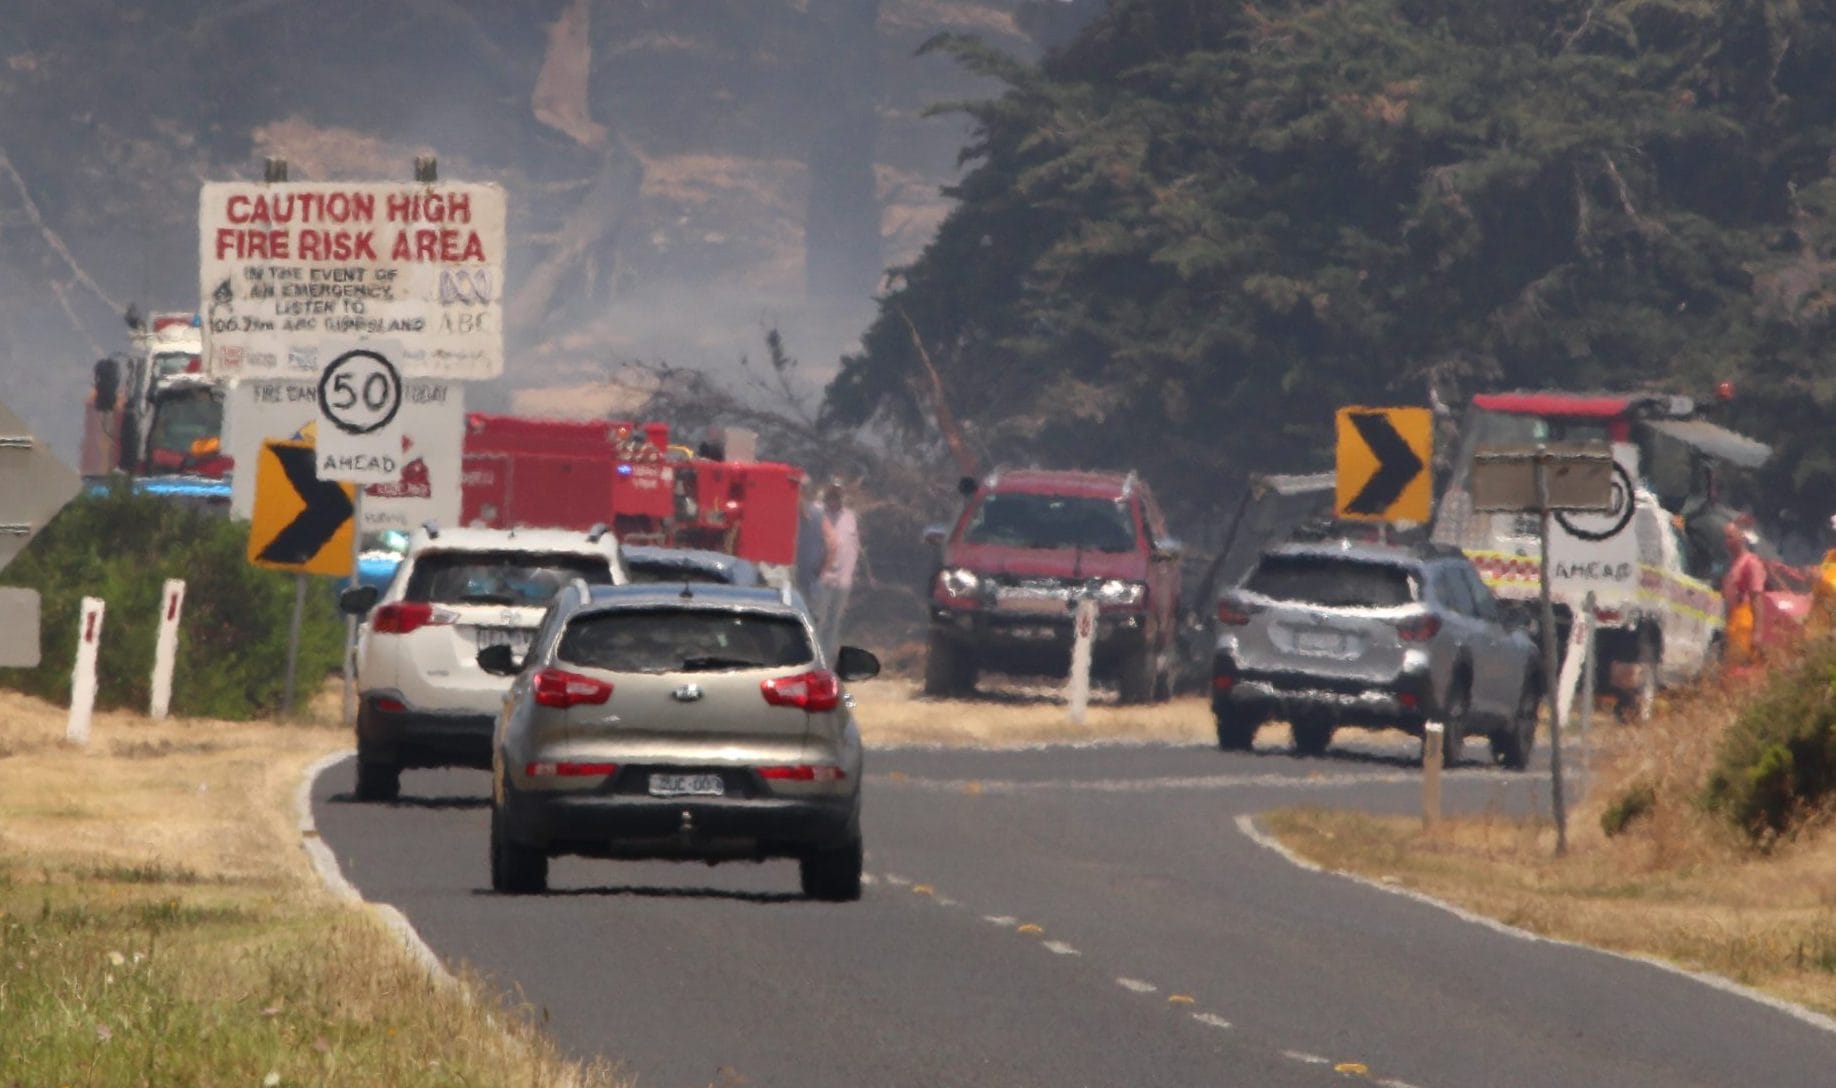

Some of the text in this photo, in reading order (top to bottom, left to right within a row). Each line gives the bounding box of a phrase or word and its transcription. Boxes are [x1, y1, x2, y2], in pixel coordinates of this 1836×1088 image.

[227, 192, 471, 224] CAUTION HIGH
[217, 228, 486, 262] FIRE RISK AREA
[269, 267, 302, 279] THE
[310, 268, 365, 282] EVENT
[375, 269, 398, 280] OF
[276, 301, 365, 315] LISTEN TO
[440, 312, 489, 334] ABC
[333, 371, 389, 411] 50
[323, 454, 396, 473] AHEAD
[1556, 561, 1631, 581] AHEAD
